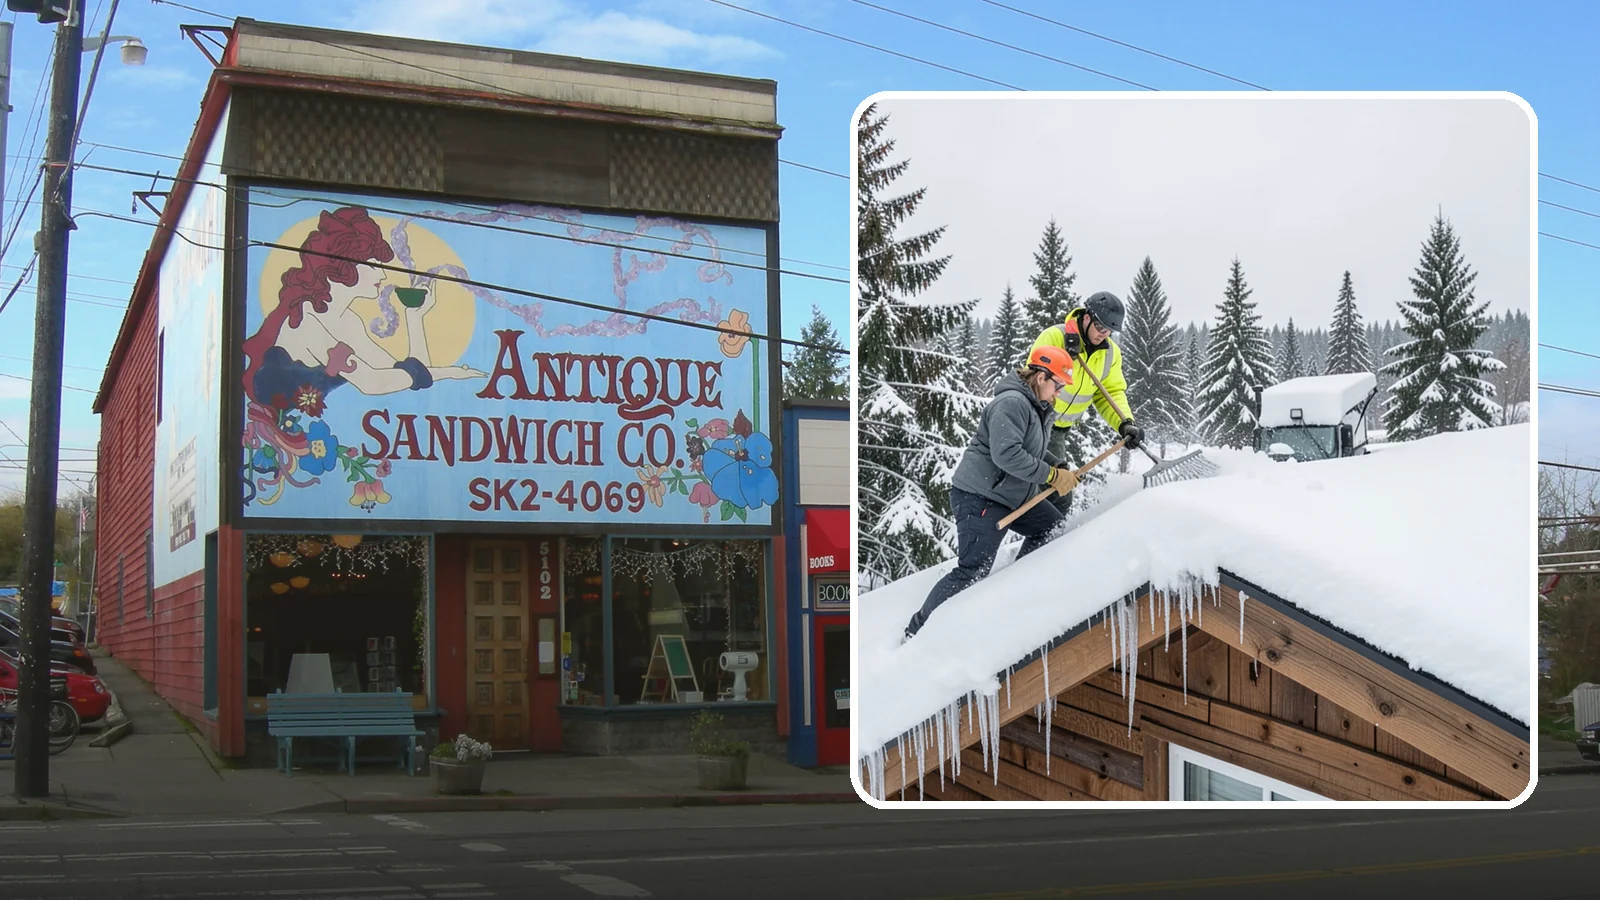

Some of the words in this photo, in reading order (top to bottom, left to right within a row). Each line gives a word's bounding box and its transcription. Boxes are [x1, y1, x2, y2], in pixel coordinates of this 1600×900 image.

[476, 329, 723, 421] ANTIQUE
[362, 409, 605, 467] SANDWICH
[617, 422, 685, 468] CO.
[469, 477, 645, 513] SK2-4069
[540, 542, 552, 599] 5102
[809, 555, 835, 569] BOOKS
